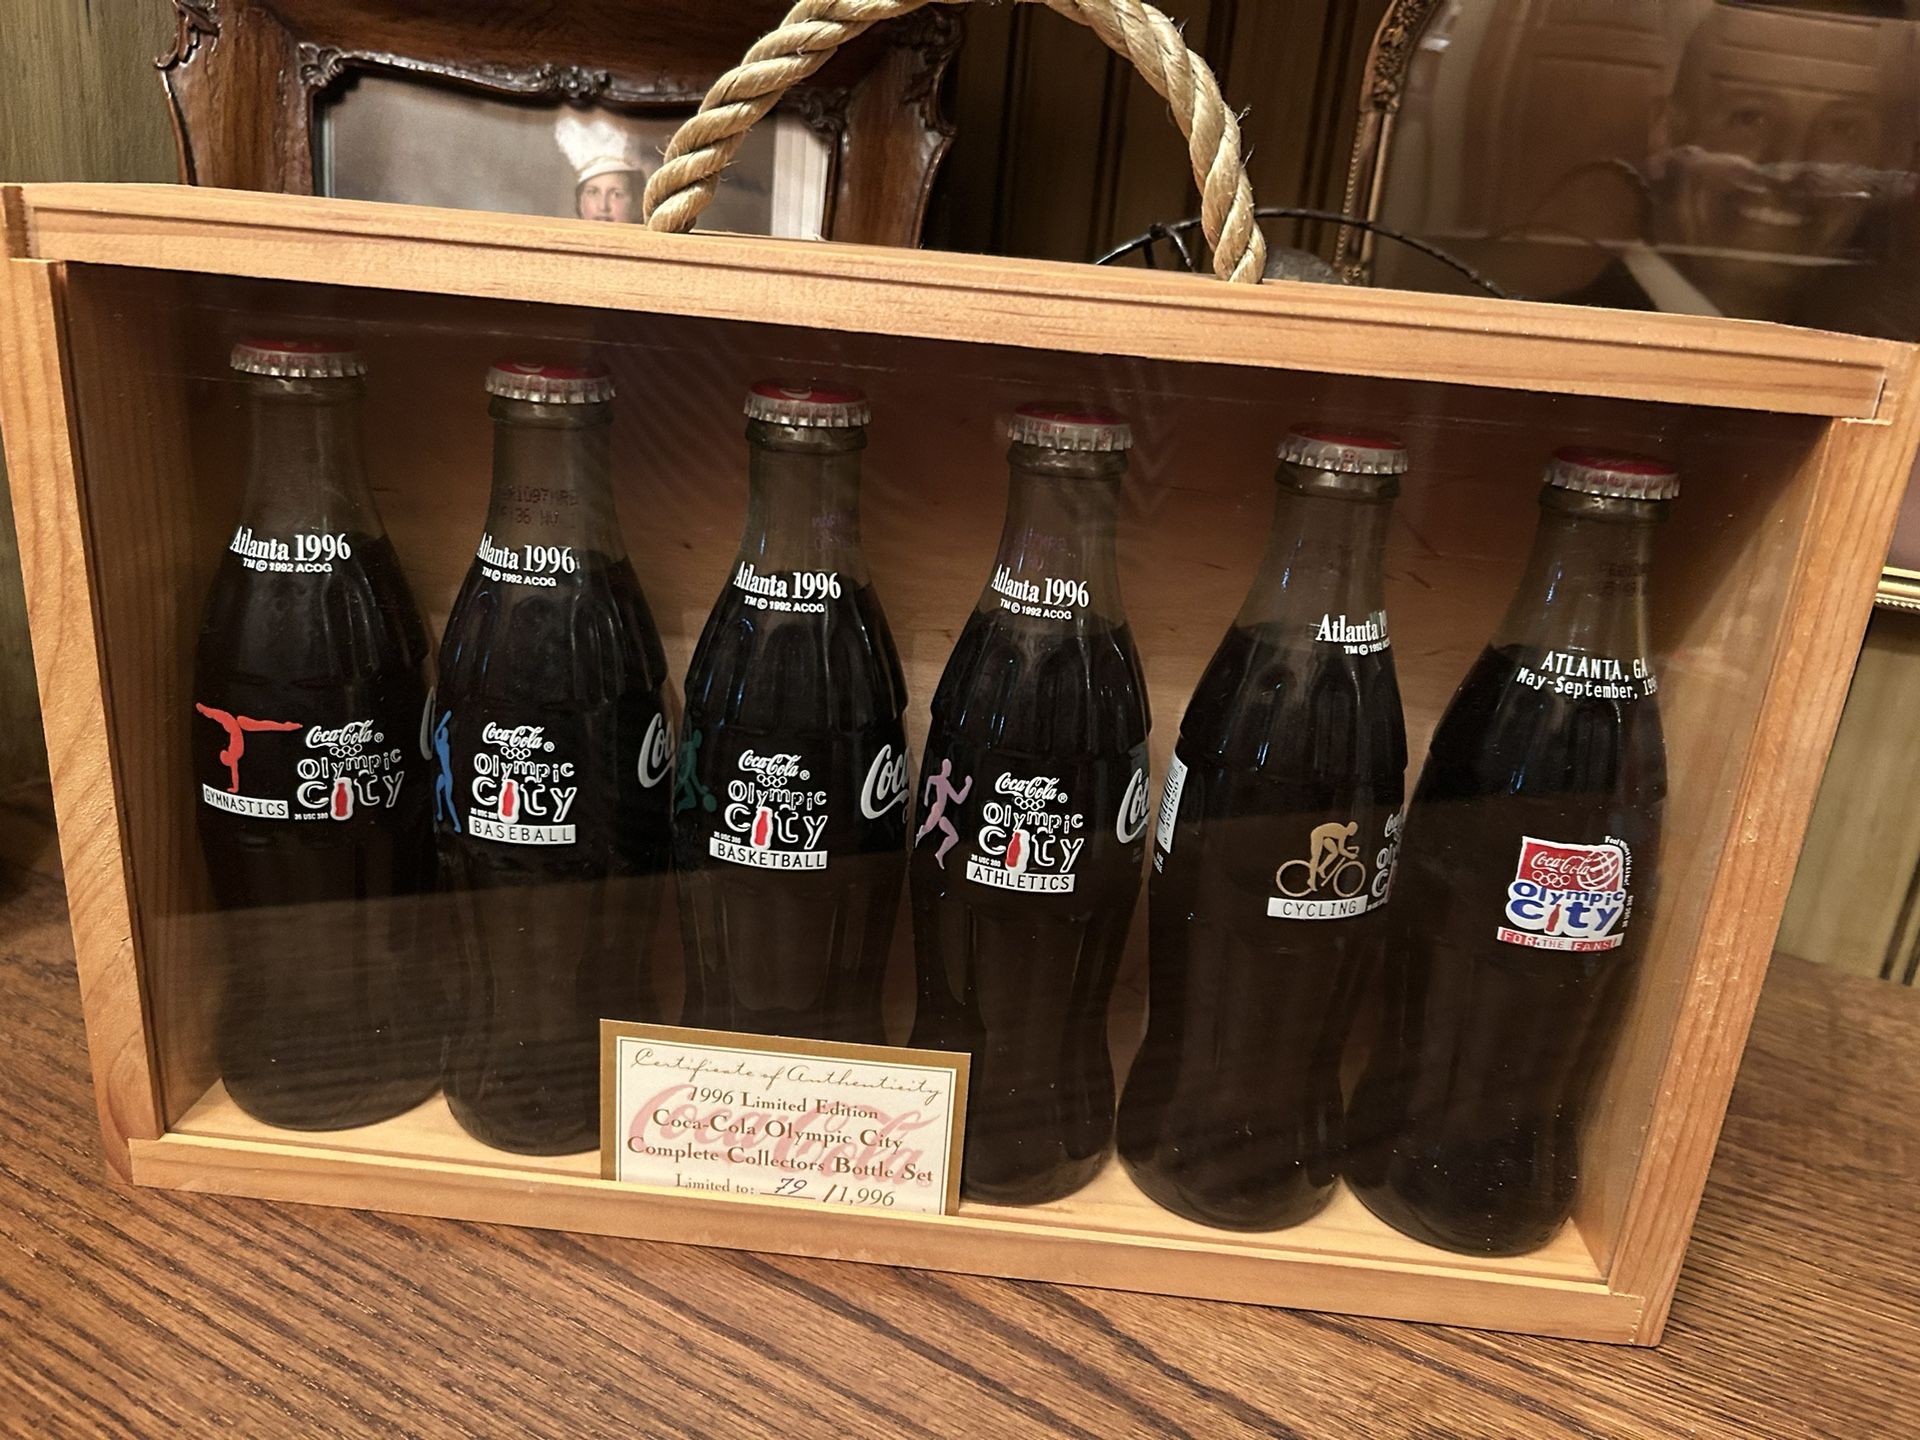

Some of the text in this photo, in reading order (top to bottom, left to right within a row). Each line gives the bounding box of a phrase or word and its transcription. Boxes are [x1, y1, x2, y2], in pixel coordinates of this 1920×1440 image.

[229, 525, 352, 561] Atlanta 1996
[476, 532, 575, 573] Atlanta 1996
[269, 562, 293, 572] 1992
[295, 563, 333, 573] ACOG
[502, 572, 523, 584] 1992
[523, 576, 557, 587] ACOG
[733, 560, 842, 599] Atlanta 1996
[991, 563, 1090, 608] Atlanta 1996
[769, 600, 792, 612] 1992
[792, 602, 825, 613] ACOG
[1021, 605, 1042, 617] 1992
[1043, 608, 1072, 620] ACOG
[1315, 613, 1379, 643] Atlanta
[1540, 650, 1649, 682] ATLANTA, GA
[1516, 667, 1638, 700] May-September,
[305, 719, 374, 749] Coca-Cola
[482, 721, 545, 749] Coca-Cola
[297, 748, 402, 781] Olympic
[474, 752, 575, 783] Olympic
[738, 749, 802, 777] Coca-Cola
[728, 780, 827, 811] Olympic
[995, 772, 1060, 800] Coca-Cola
[205, 788, 286, 816] GYMNASTICS
[474, 820, 572, 842] BASEBALL
[983, 802, 1084, 834] Olympic
[718, 843, 825, 868] BASKETBALL
[1531, 851, 1592, 876] Coca-Cola
[973, 866, 1070, 890] ATHLETICS
[1513, 881, 1624, 906] Olympic
[1282, 900, 1357, 917] CYCLING
[1503, 931, 1617, 951] FOR THE FANS!
[630, 1047, 943, 1106] Certificate of Authenticity
[690, 1086, 879, 1119] 1996 Limited Edition
[652, 1108, 904, 1154] Coca-Cola Olympic City
[627, 1135, 934, 1182] Complete Collectors Bottle Set
[675, 1173, 730, 1193] Limited
[736, 1184, 755, 1195] to:
[775, 1177, 808, 1195] 79
